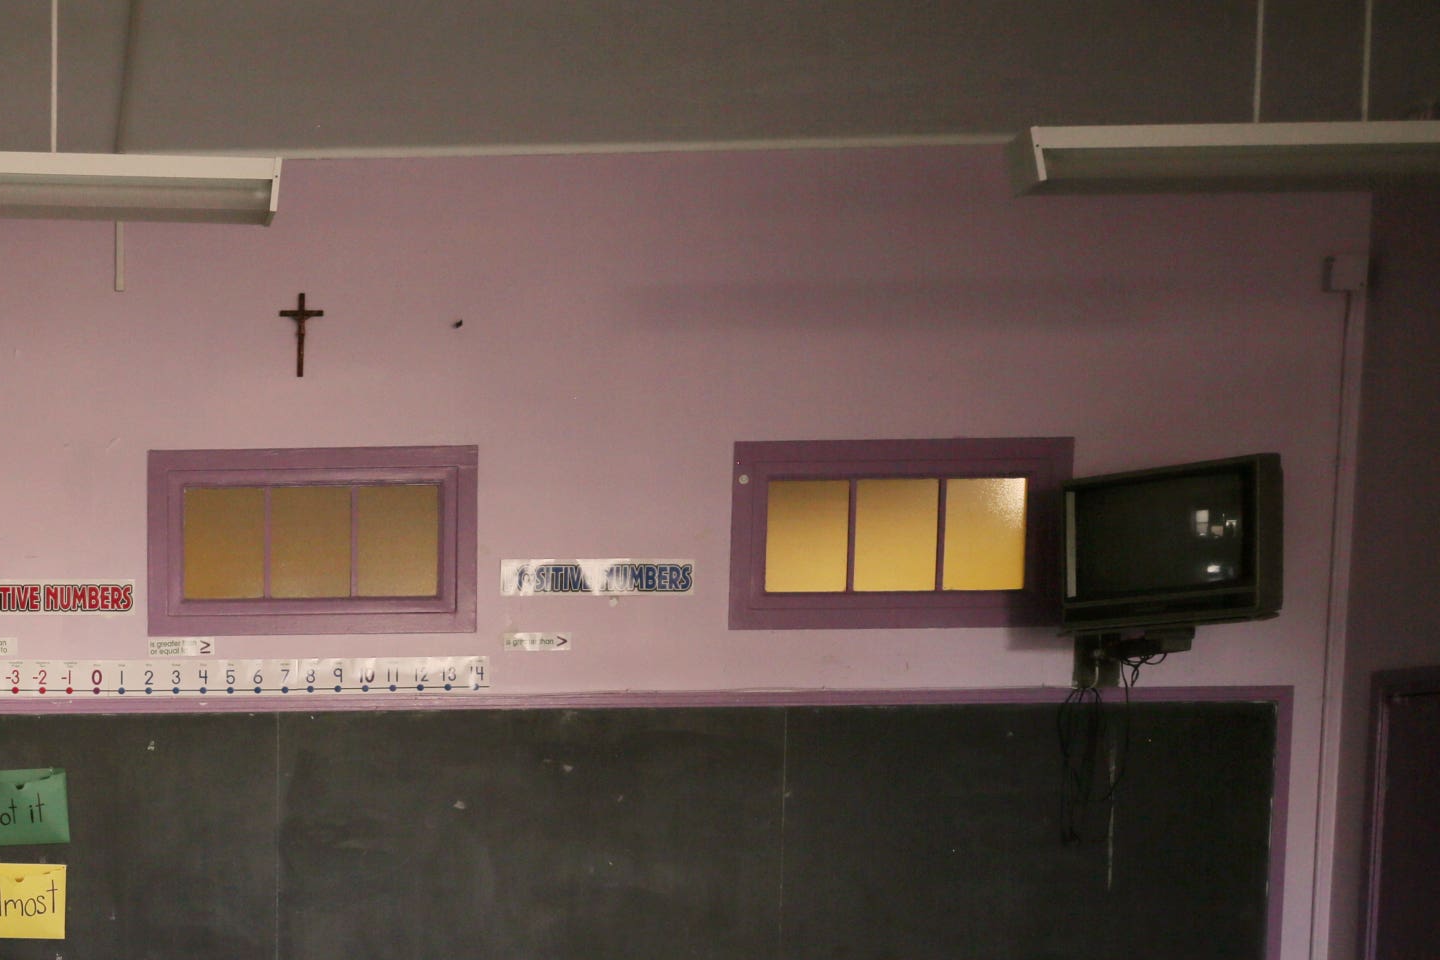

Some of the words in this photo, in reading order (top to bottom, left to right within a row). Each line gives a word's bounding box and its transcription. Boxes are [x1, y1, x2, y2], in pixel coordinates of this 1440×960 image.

[44, 584, 133, 612] NUMBERS
[5, 669, 20, 685] -3
[32, 669, 47, 685] -2
[61, 669, 71, 685] -1
[91, 669, 102, 685] 0
[144, 670, 153, 685] 2
[171, 670, 181, 685] 3
[198, 669, 208, 685] 4
[226, 669, 235, 685] 5
[253, 669, 263, 685] 6
[280, 669, 290, 684] 7
[306, 669, 316, 683] 8
[333, 667, 343, 683] 9
[387, 667, 399, 682] 11
[414, 668, 430, 682] 12
[442, 667, 457, 682] 13
[29, 792, 45, 823] it
